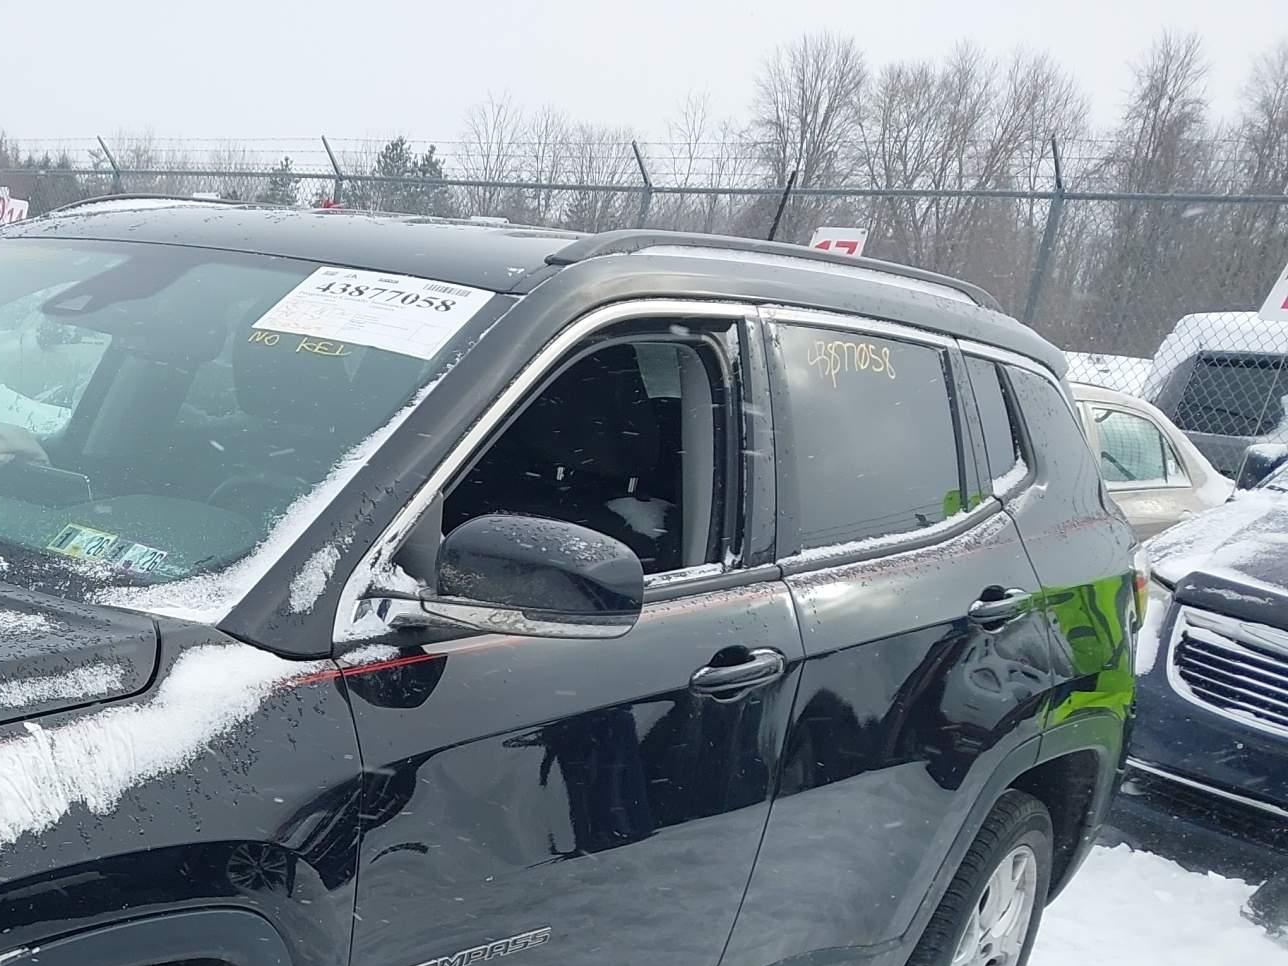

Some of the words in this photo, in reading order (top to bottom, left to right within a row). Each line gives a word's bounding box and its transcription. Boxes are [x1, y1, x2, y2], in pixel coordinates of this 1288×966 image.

[315, 281, 458, 313] 43877058
[248, 330, 281, 347] NO
[85, 536, 111, 557] 26
[139, 551, 164, 572] 26
